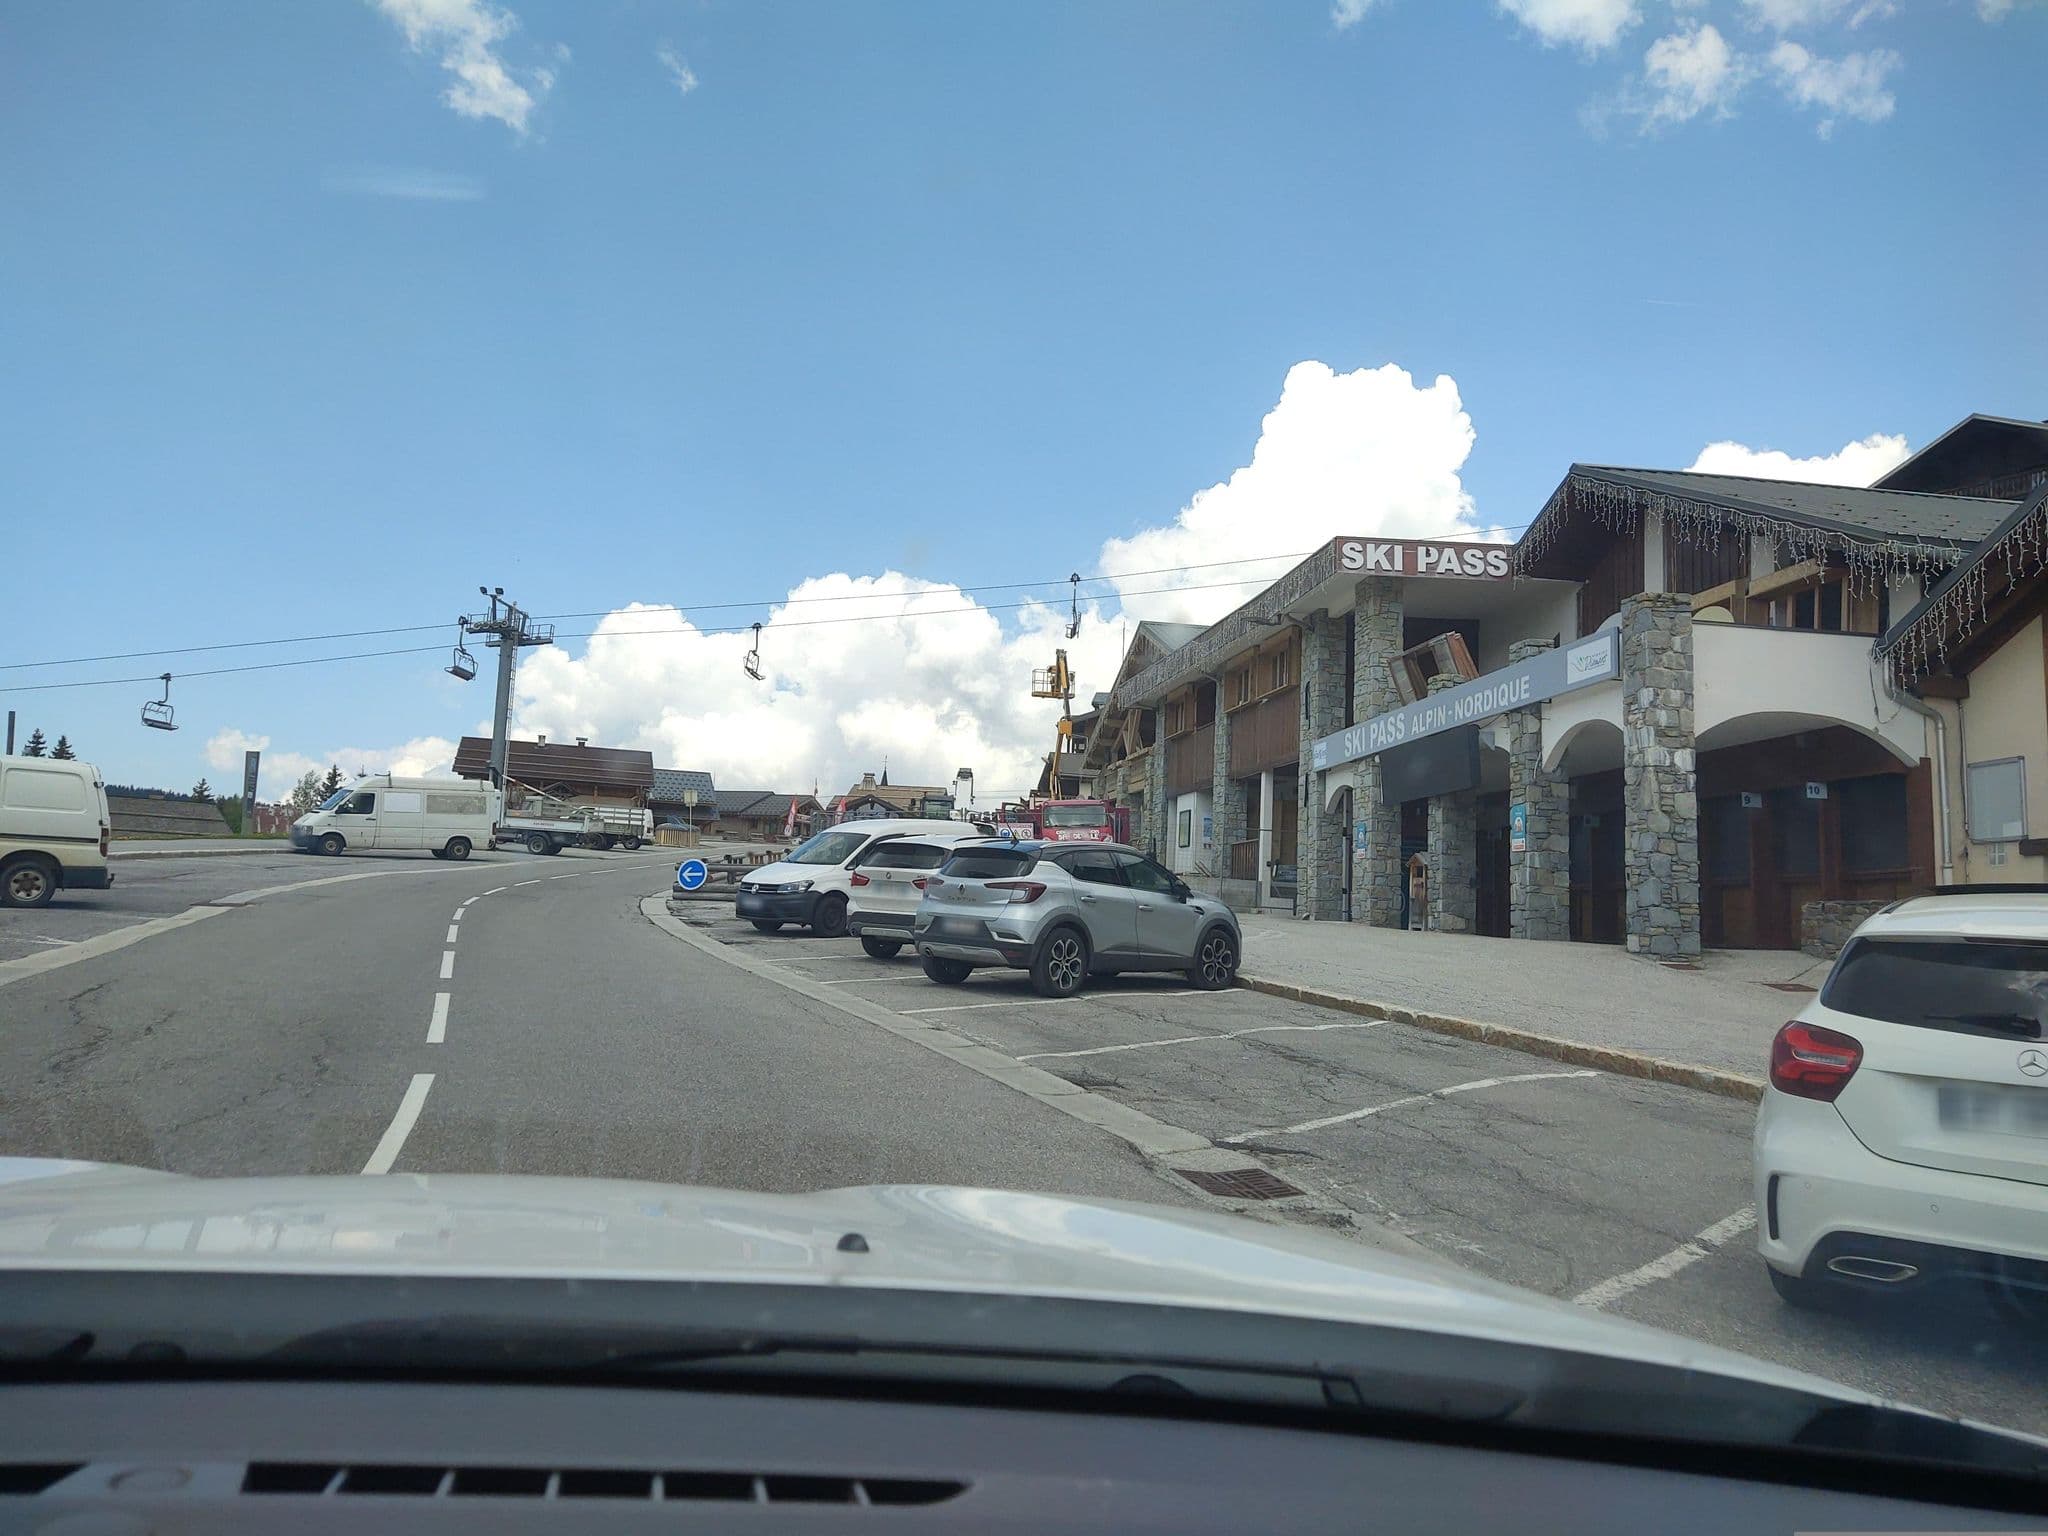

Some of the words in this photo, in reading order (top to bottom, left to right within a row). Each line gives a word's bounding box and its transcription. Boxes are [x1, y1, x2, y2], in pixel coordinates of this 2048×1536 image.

[1341, 542, 1403, 572] SKI
[1417, 546, 1508, 577] PASS
[1344, 727, 1366, 757] SKI
[1370, 712, 1405, 749] PASS
[1411, 704, 1446, 736] ALPIN
[1454, 674, 1531, 721] NORDIQUE
[1743, 794, 1751, 805] 9
[1808, 785, 1820, 795] 10
